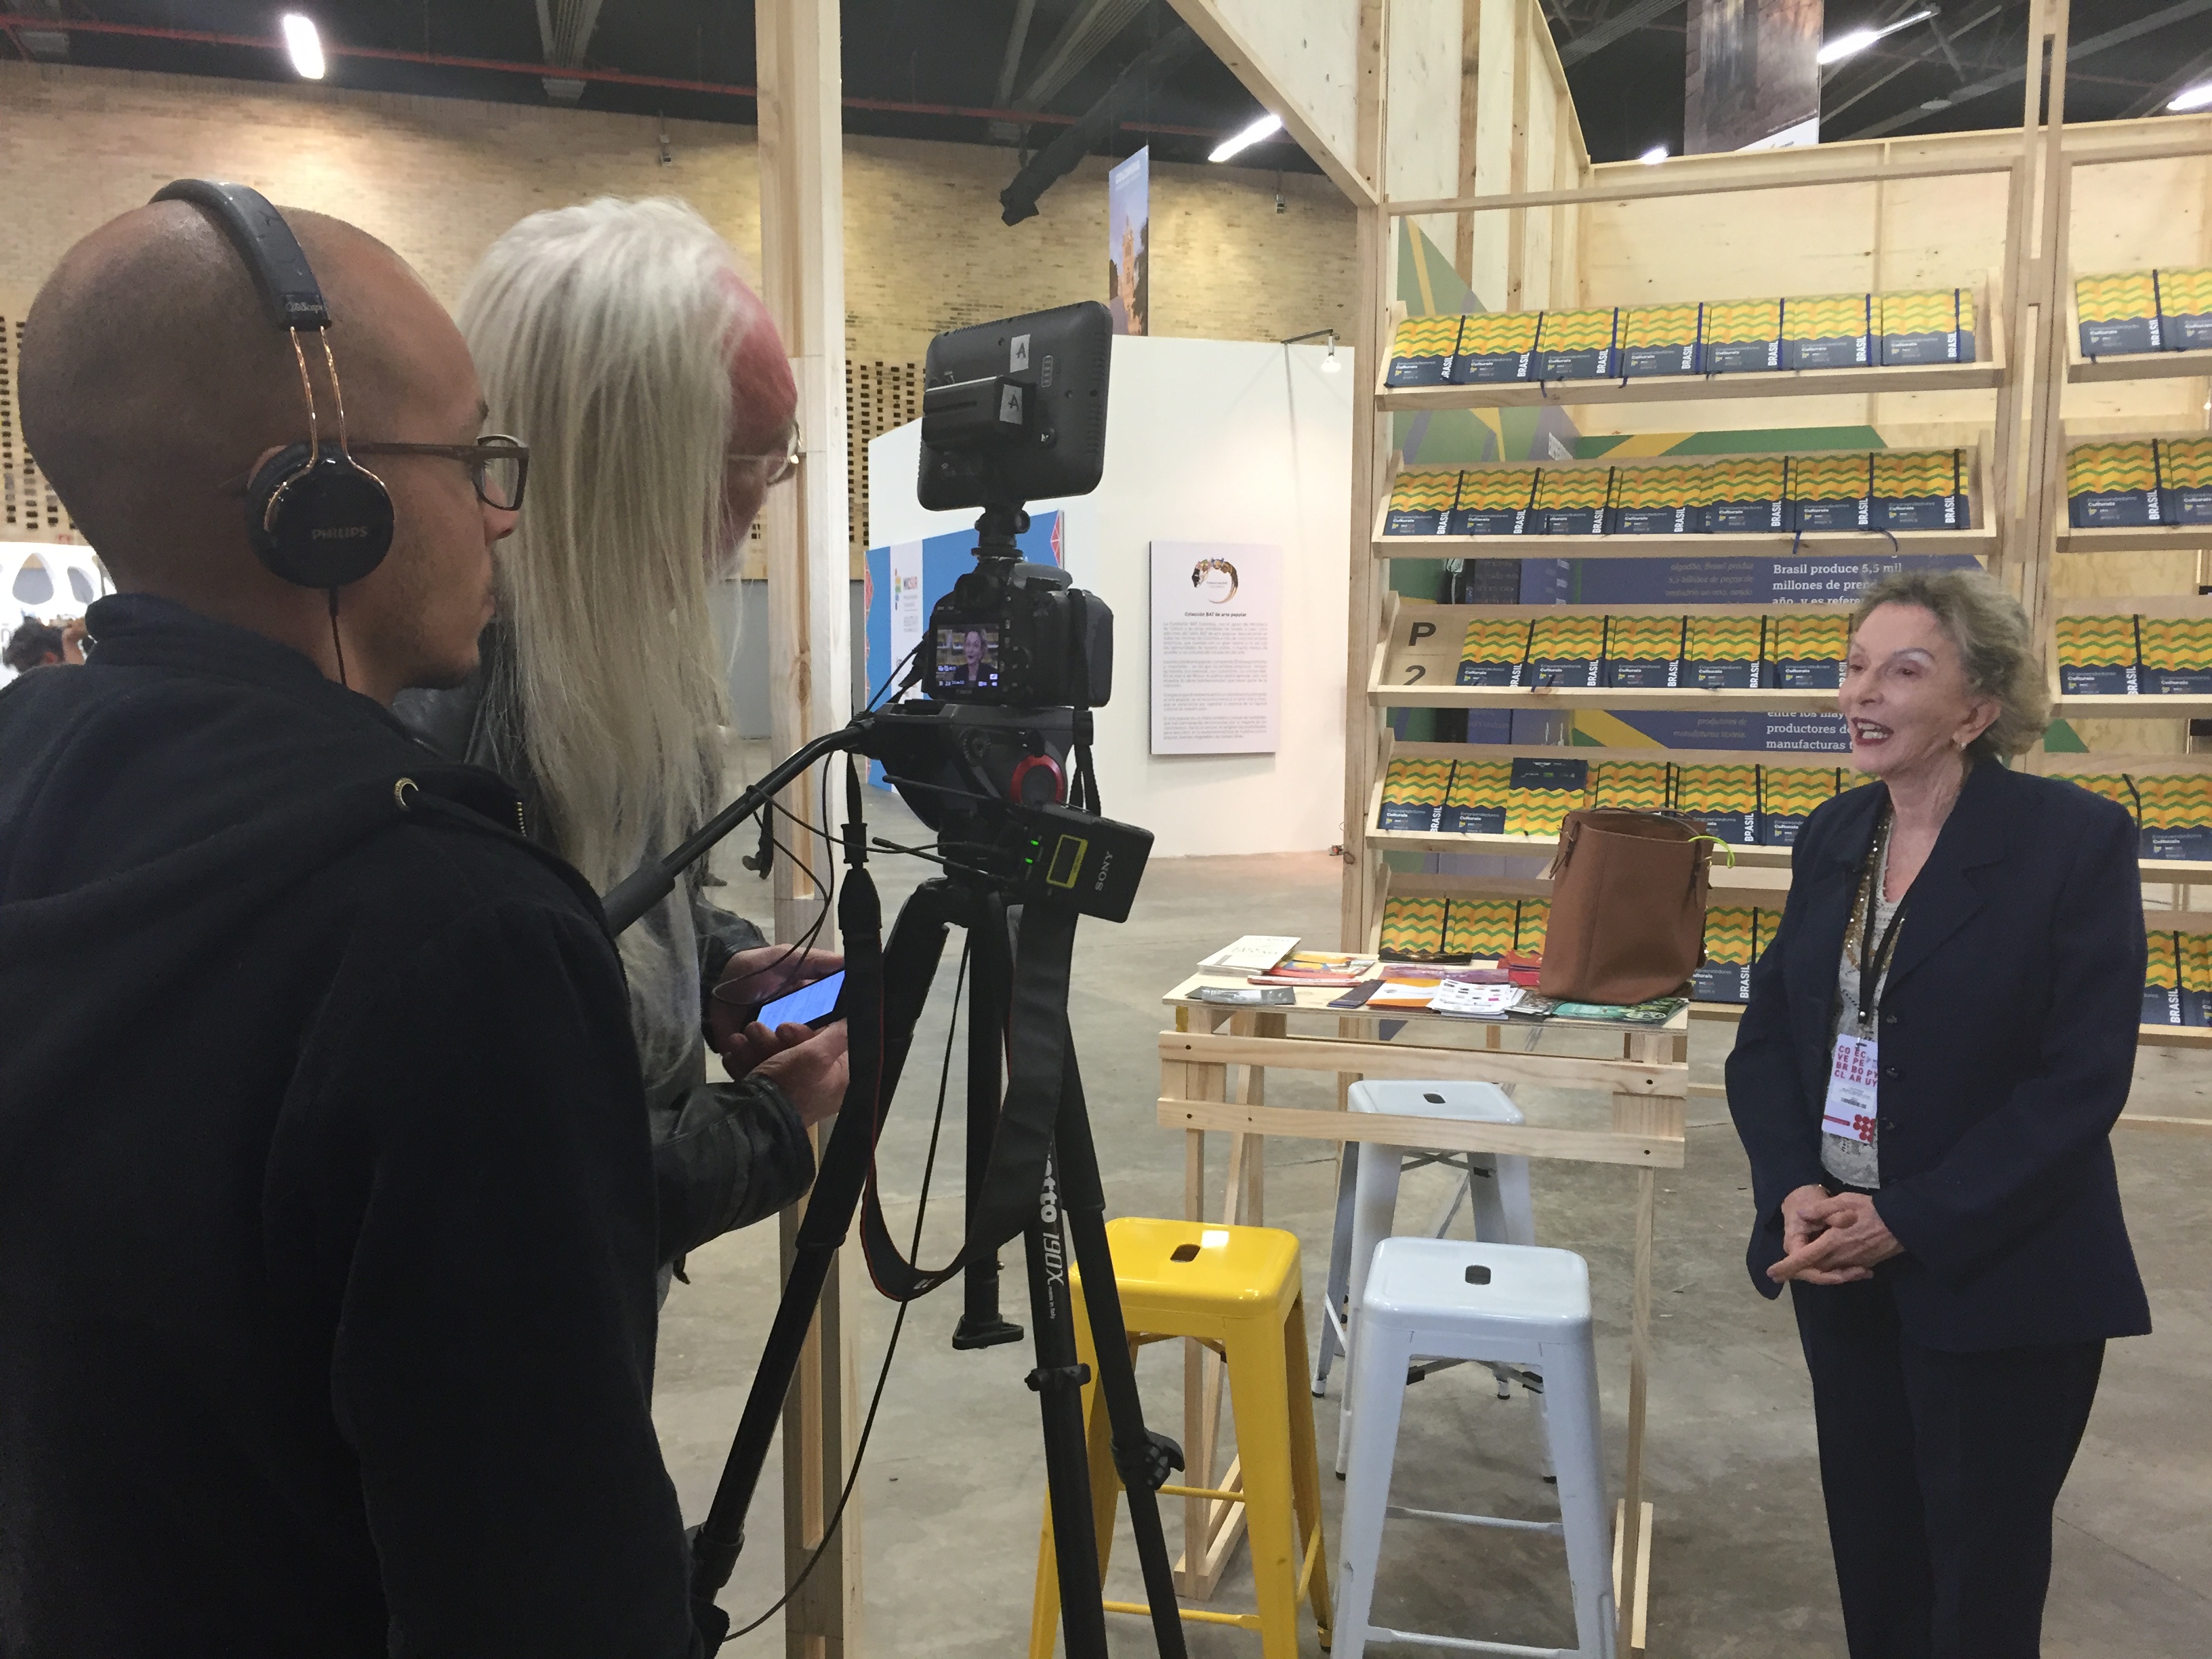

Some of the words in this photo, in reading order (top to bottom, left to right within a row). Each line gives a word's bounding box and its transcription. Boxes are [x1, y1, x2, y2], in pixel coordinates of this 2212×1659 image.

[1016, 342, 1026, 359] A
[1681, 344, 1693, 369] BRASIL
[1767, 341, 1778, 366] BRASIL
[1856, 336, 1866, 362] BRASIL
[1948, 332, 1957, 358] BRASIL
[1441, 356, 1454, 379] RASIL
[1517, 352, 1530, 377] BRASIL
[1597, 349, 1608, 373] BRASIL
[1008, 394, 1019, 410] A
[1771, 501, 1782, 527] BRASIL
[1858, 498, 1868, 525] BRASIL
[1944, 495, 1955, 524] BRASIL
[2146, 489, 2160, 520] BRASIL
[312, 526, 368, 539] PHILIPS
[1437, 510, 1450, 535] BRASIL
[1513, 510, 1526, 534] BRASIL
[1593, 508, 1604, 533] BRASIL
[1674, 508, 1685, 533] BRASIL
[1773, 564, 1807, 574] Brasil
[1810, 564, 1859, 575] produce
[1861, 563, 1880, 575] 5,5
[1772, 580, 1823, 590] millones
[1826, 580, 1841, 590] de
[1408, 621, 1436, 646] P
[1403, 665, 1426, 685] 2
[1509, 663, 1523, 687] BRASIL
[1587, 659, 1599, 687] BRASIL
[1667, 660, 1679, 687] BRASIL
[1749, 661, 1760, 688] BRASIL
[1767, 723, 1836, 734] productores
[1820, 712, 1844, 720] may
[1766, 739, 1845, 750] manufacturas
[1430, 806, 1443, 832] BRASIL
[1744, 813, 1754, 842] BRASIL
[1094, 851, 1113, 890] SONY
[1740, 965, 1750, 998] BRASIL
[2168, 989, 2181, 1023] BRASIL
[1837, 1053, 1849, 1063] VE
[1853, 1057, 1864, 1067] PE
[1838, 1045, 1851, 1054] CO
[1854, 1049, 1866, 1058] EC
[1834, 1069, 1845, 1079] CL
[1849, 1073, 1862, 1083] AR
[1865, 1078, 1877, 1088] UY
[1835, 1061, 1848, 1071] BR
[1850, 1065, 1864, 1076] BO
[1043, 1233, 1064, 1286] 190X
